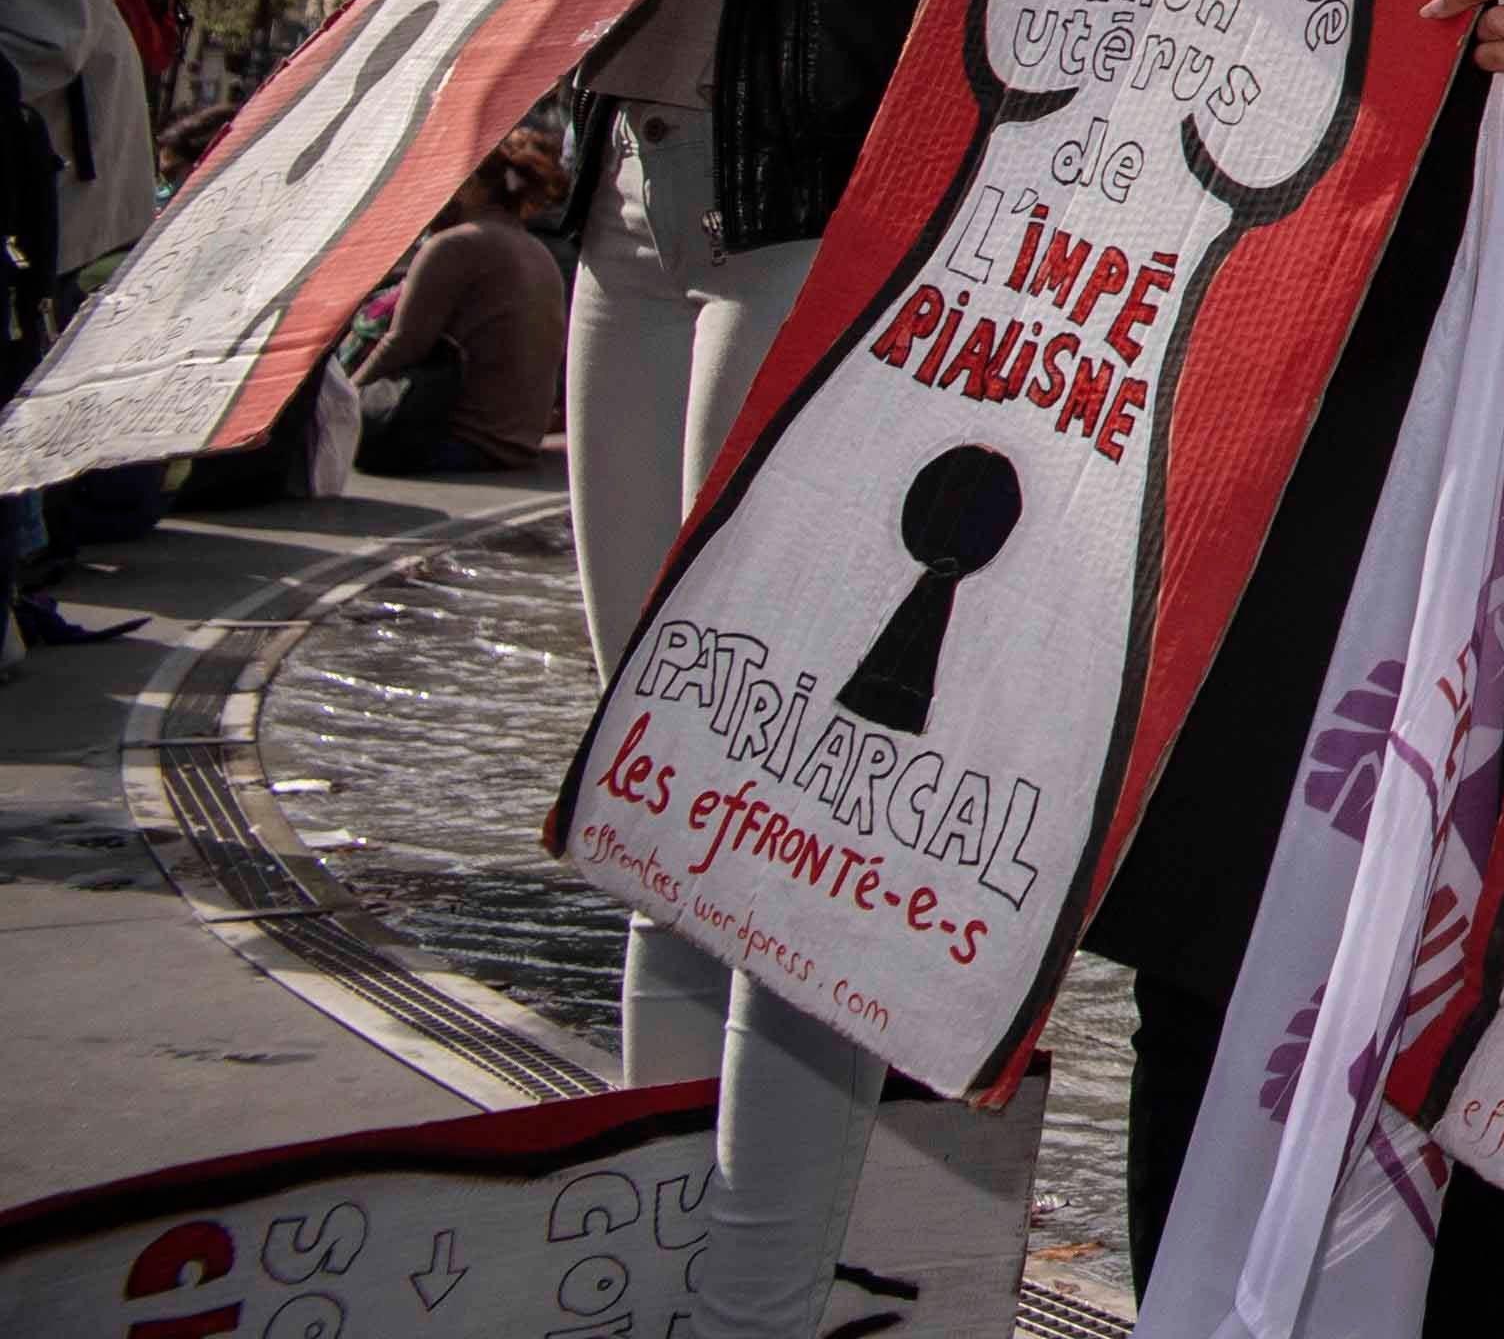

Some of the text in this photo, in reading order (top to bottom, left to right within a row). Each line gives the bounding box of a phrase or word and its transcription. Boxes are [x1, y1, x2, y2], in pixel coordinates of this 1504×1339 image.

[1013, 7, 1263, 126] utérus
[1050, 116, 1145, 205] de
[597, 710, 678, 815] les
